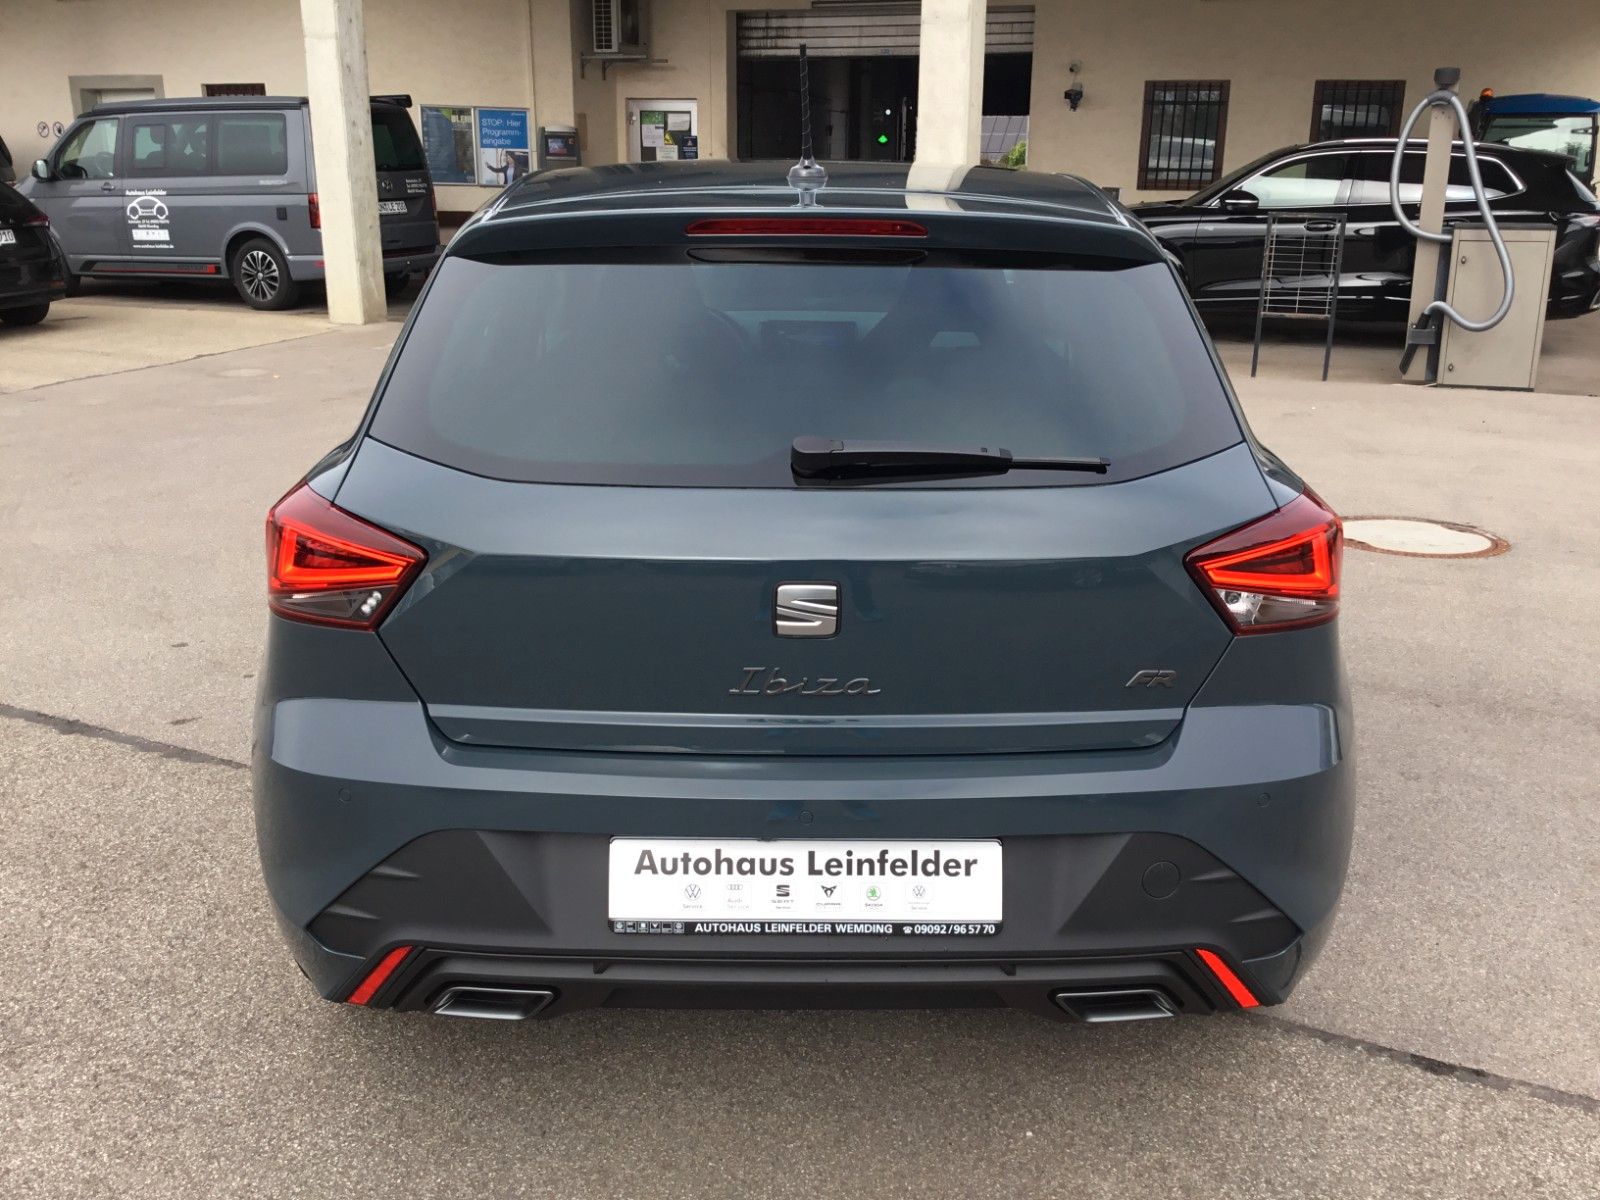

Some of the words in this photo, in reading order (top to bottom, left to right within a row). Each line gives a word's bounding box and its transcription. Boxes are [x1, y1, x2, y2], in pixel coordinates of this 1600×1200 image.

[507, 119, 521, 127] Hier
[482, 137, 512, 147] eingabe
[728, 666, 882, 695] Ibiza
[1125, 669, 1177, 688] FR
[634, 848, 795, 876] Autohaus
[807, 849, 978, 877] Leinfelder
[694, 923, 761, 933] AUTOHAUS
[764, 923, 832, 934] LEINFELDER
[835, 924, 893, 934] WEMDING
